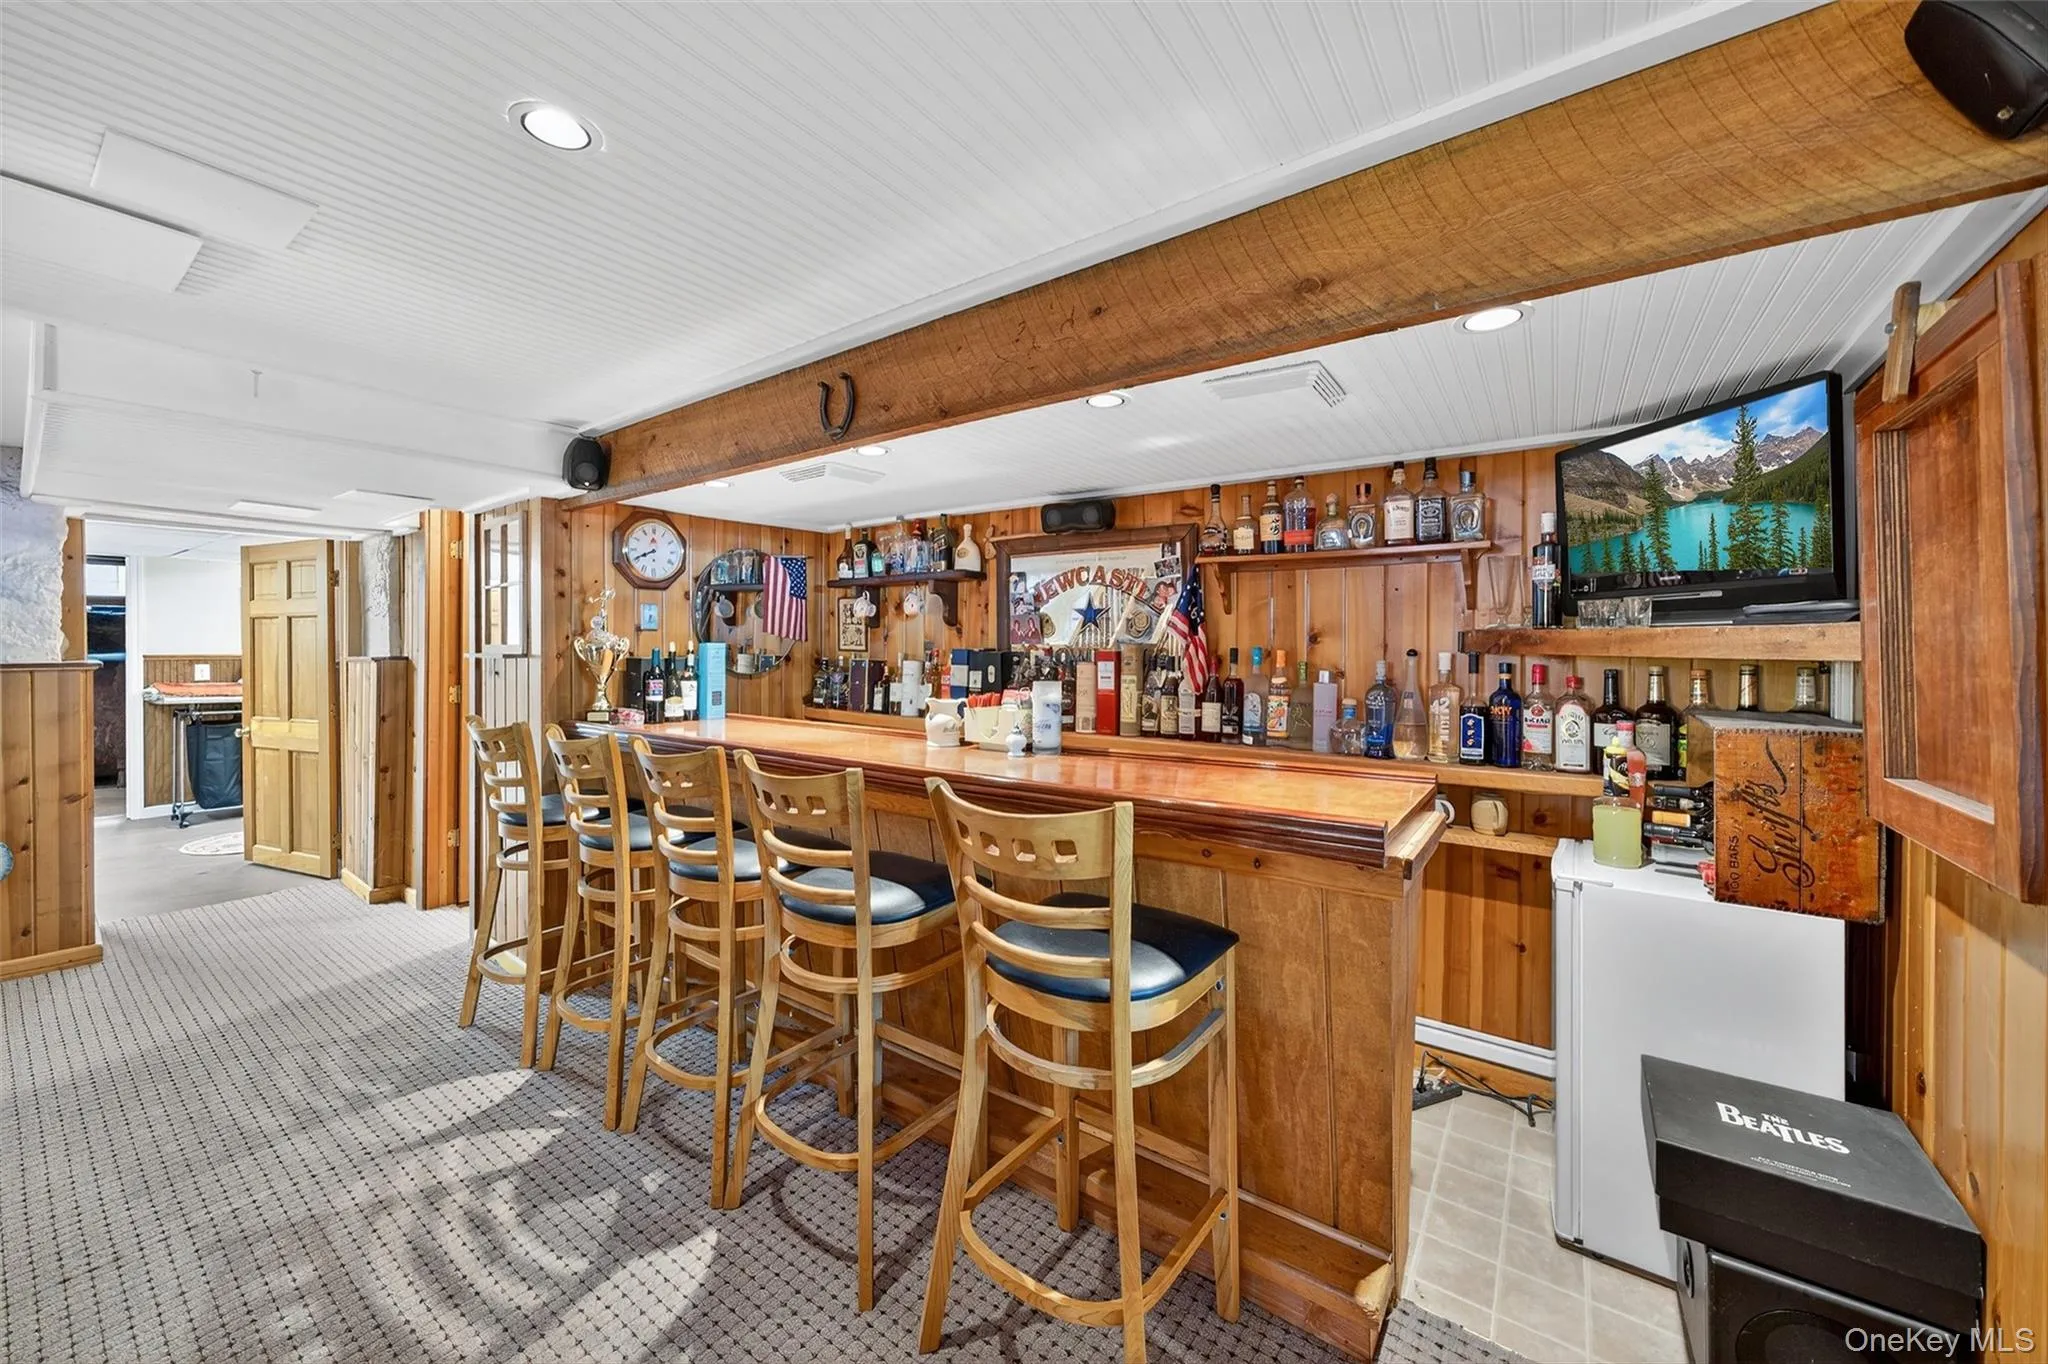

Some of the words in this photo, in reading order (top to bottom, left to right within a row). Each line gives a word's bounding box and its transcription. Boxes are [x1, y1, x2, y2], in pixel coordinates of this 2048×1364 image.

[1728, 834, 1740, 869] BARS
[1715, 1101, 1851, 1155] BEATLES
[1761, 1112, 1790, 1127] THE
